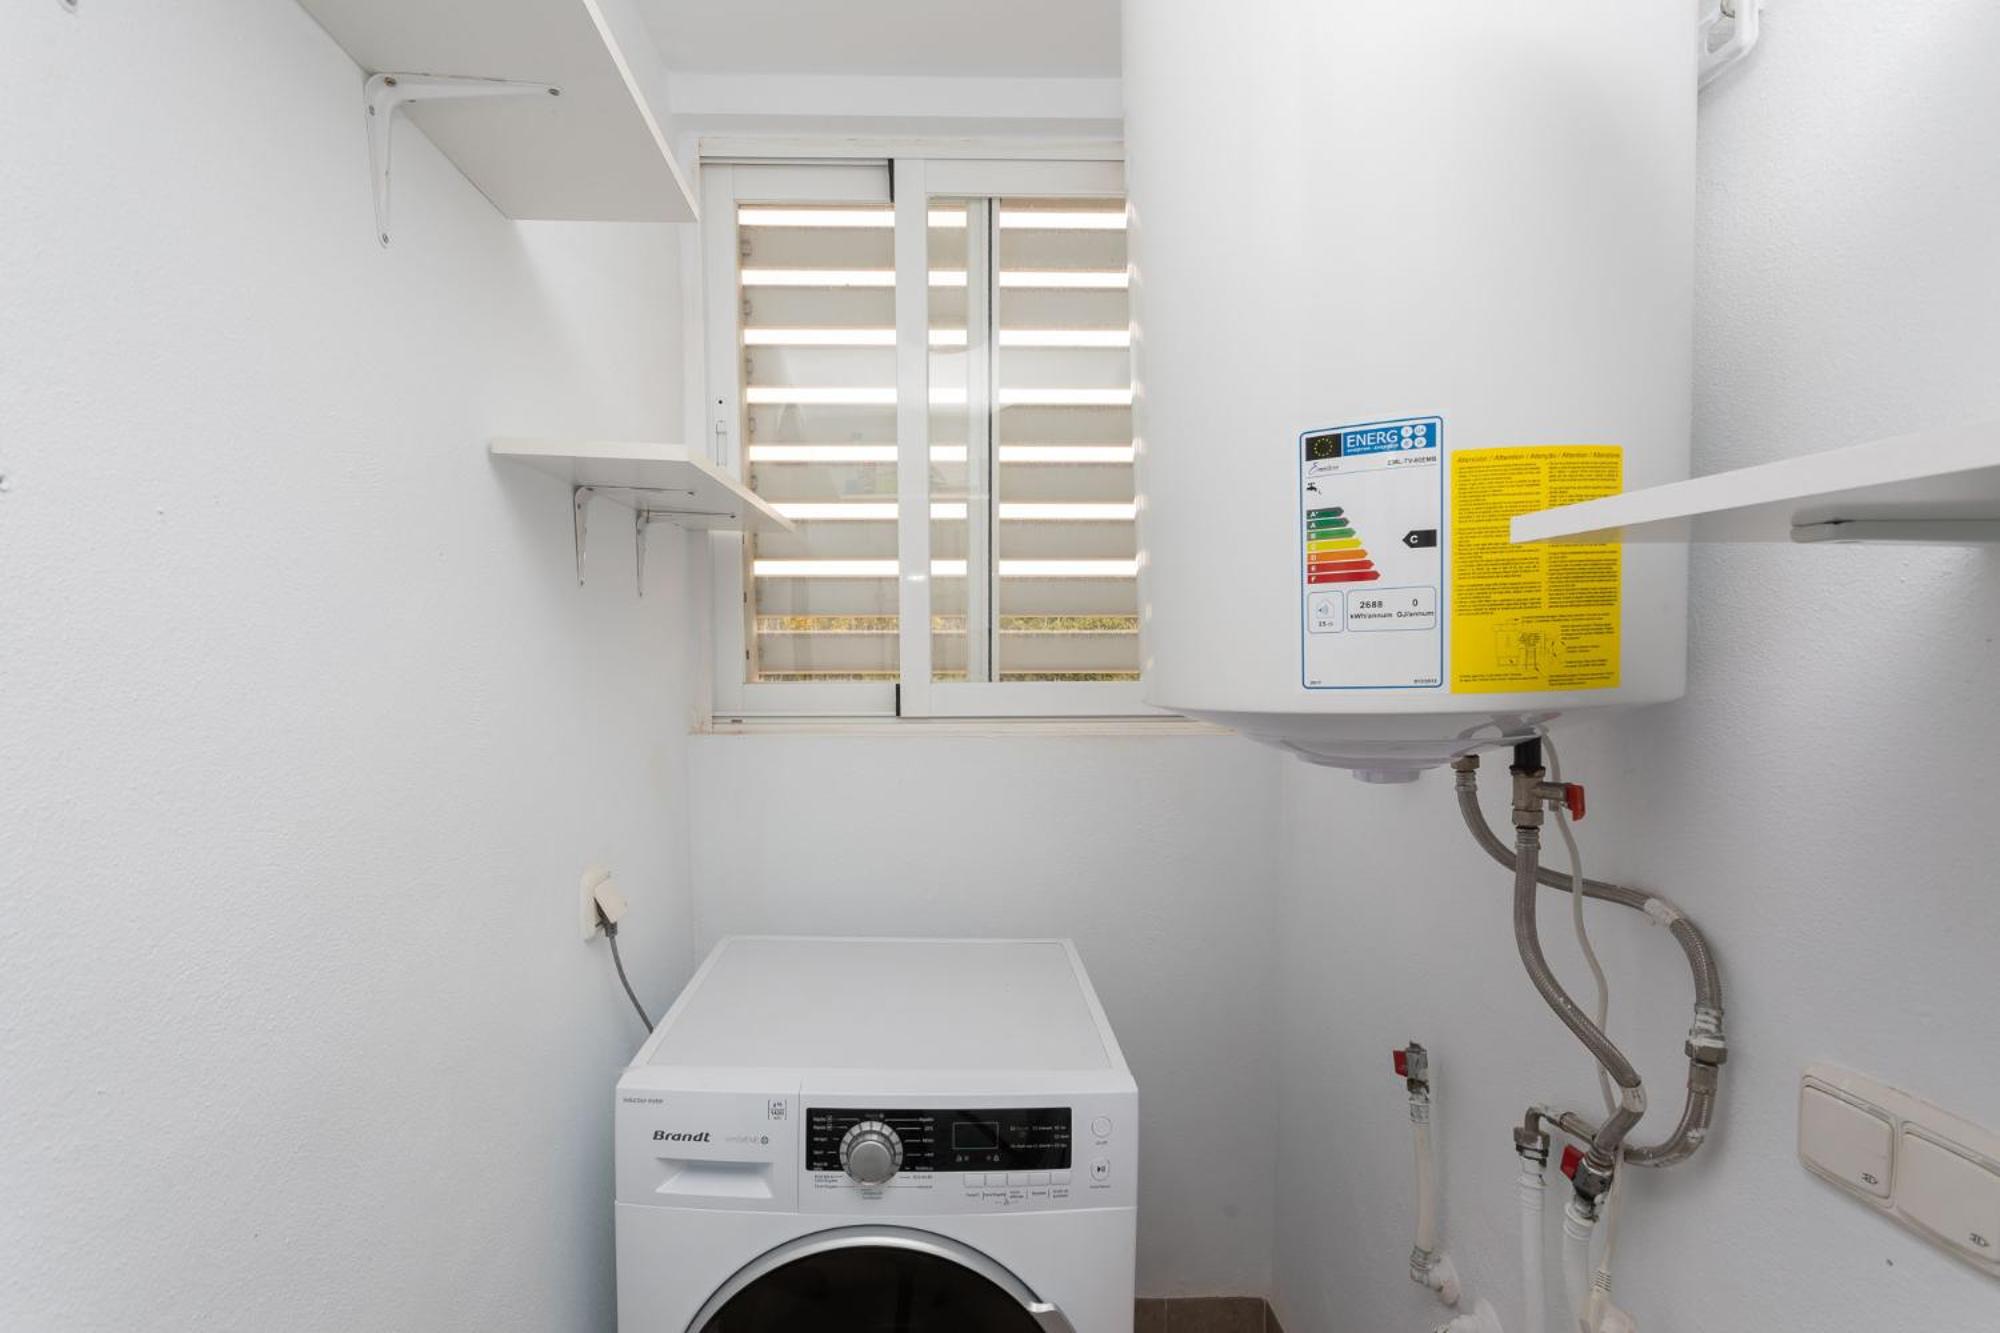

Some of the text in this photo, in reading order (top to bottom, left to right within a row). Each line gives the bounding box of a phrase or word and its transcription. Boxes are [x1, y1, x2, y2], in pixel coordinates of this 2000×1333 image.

[1346, 429, 1398, 448] ENERG
[1409, 535, 1419, 544] C
[1411, 598, 1419, 607] 0
[652, 1130, 712, 1143] Brandt
